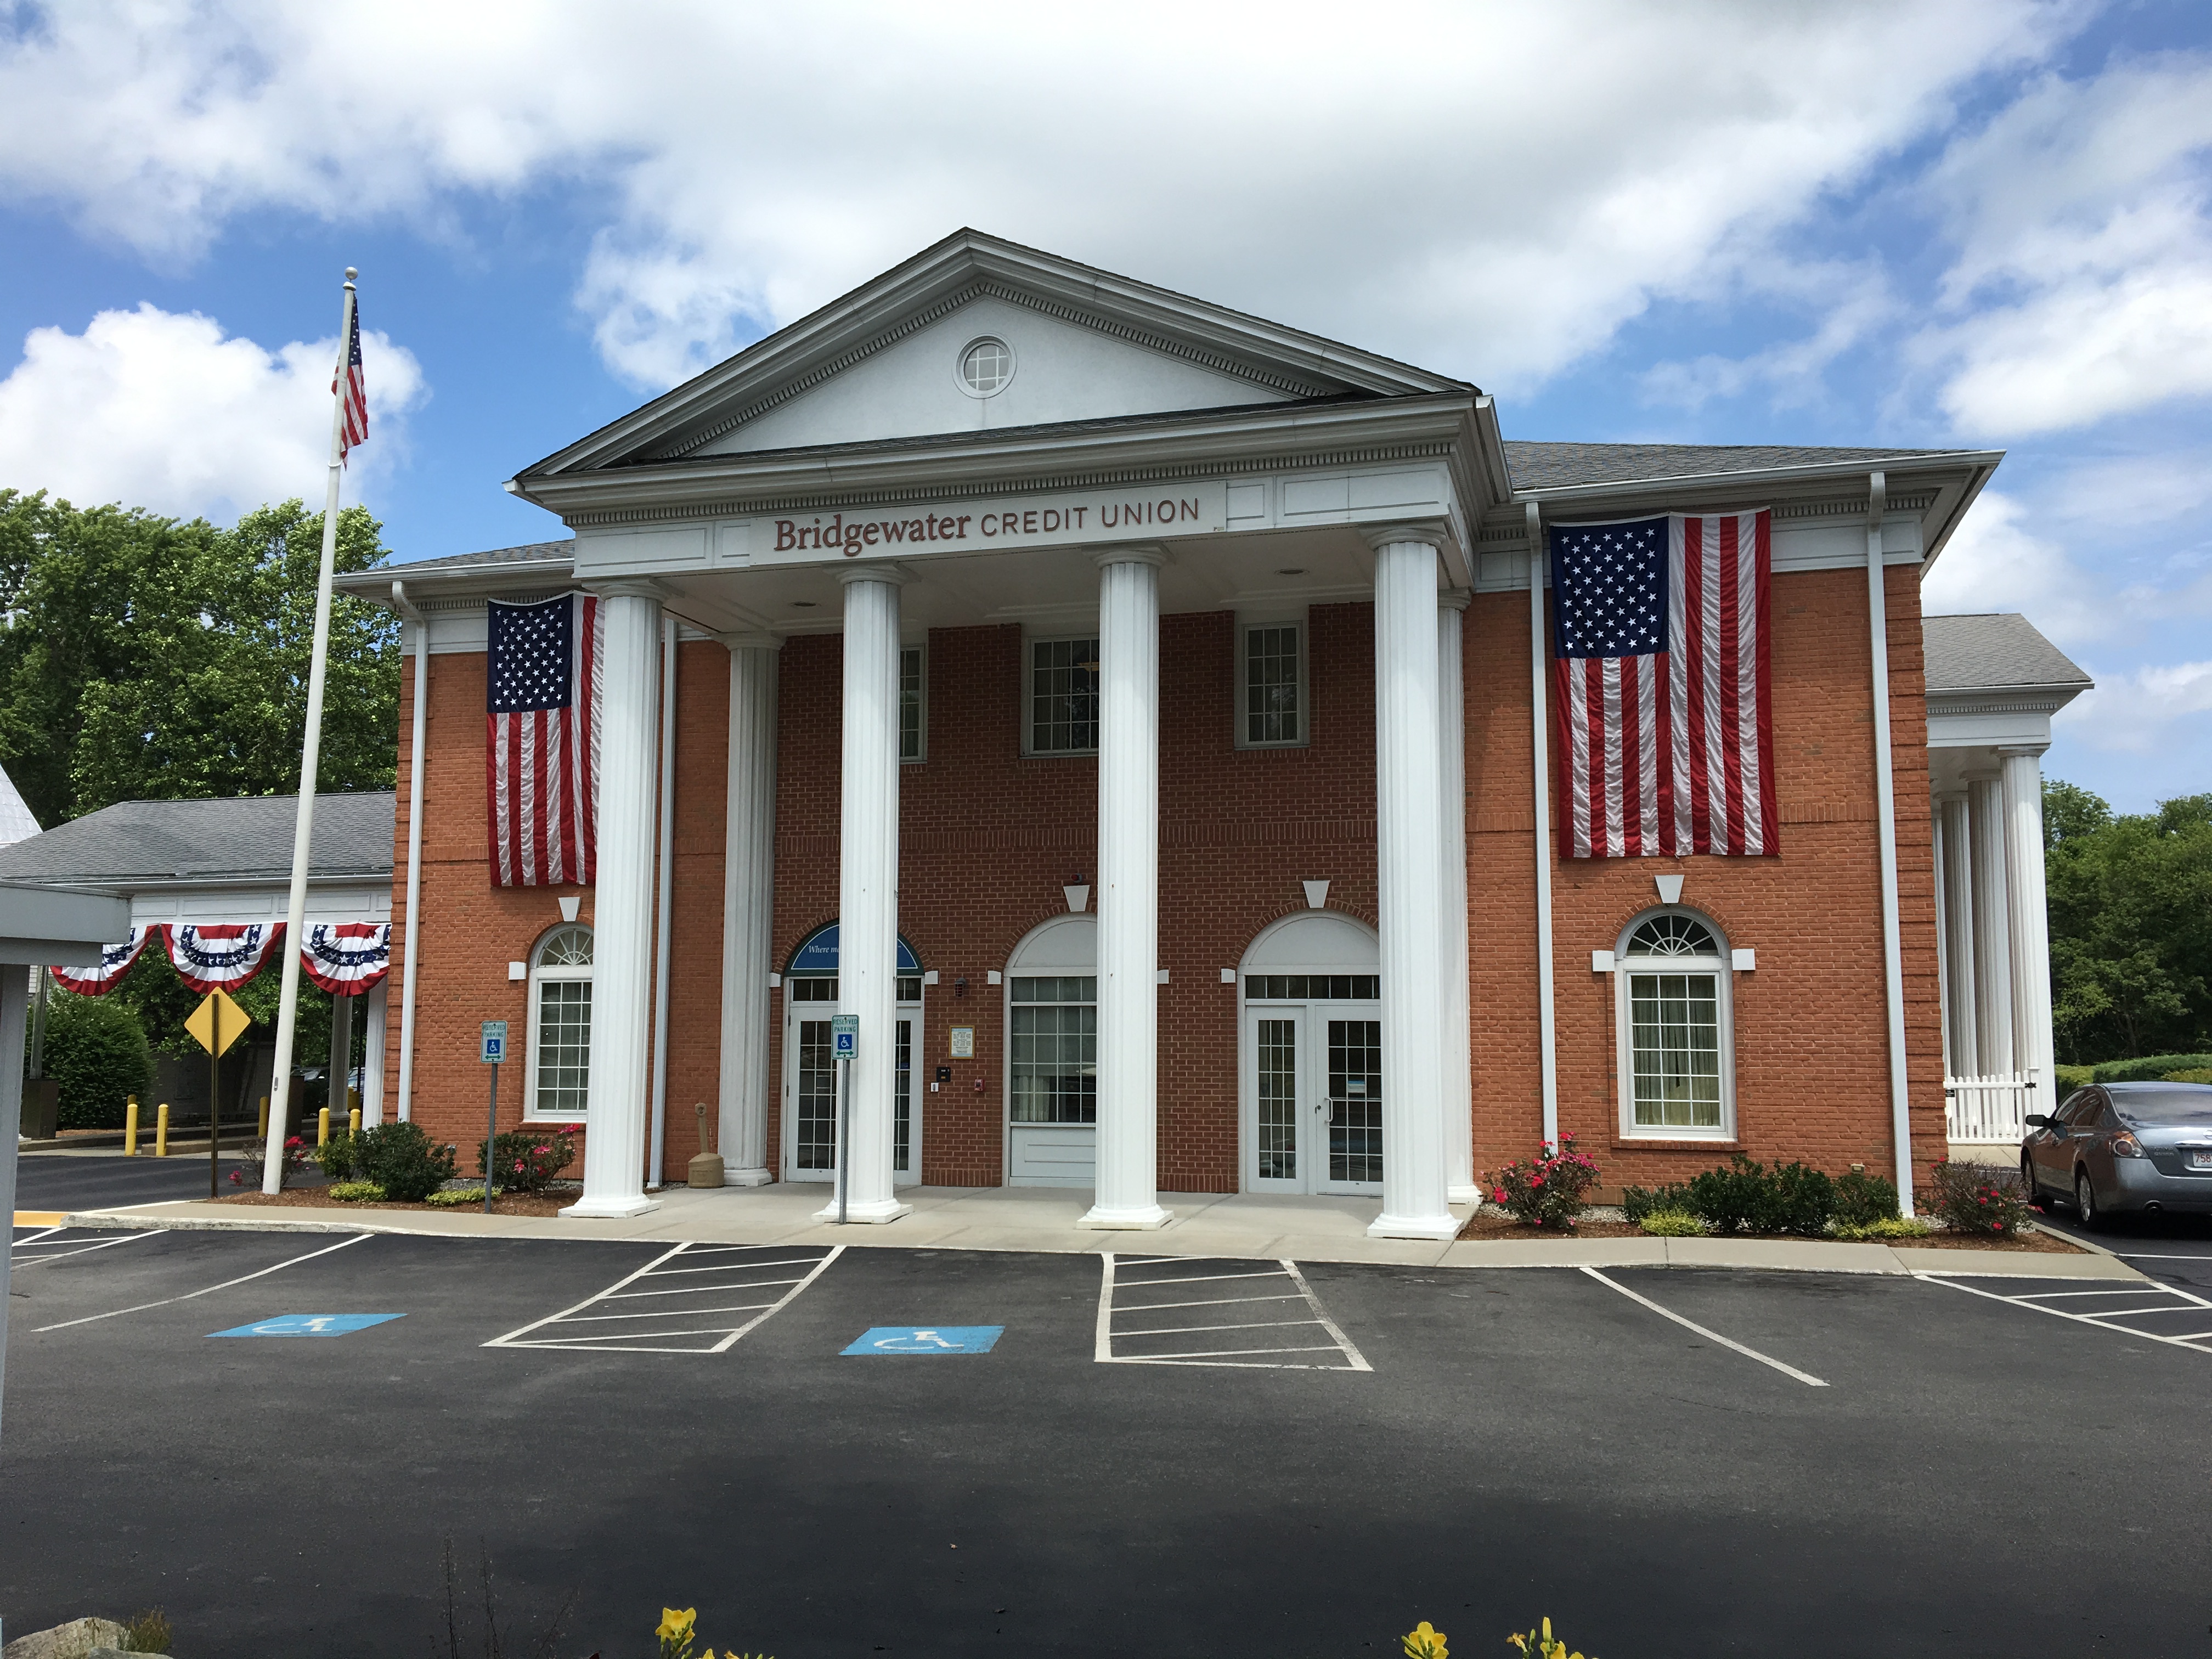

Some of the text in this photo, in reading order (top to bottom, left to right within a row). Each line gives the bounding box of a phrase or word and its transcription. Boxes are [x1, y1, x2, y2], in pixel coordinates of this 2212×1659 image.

[774, 498, 1198, 557] Bridgewater CREDIT UNION
[809, 945, 830, 953] Where
[2195, 1154, 2212, 1163] 758
